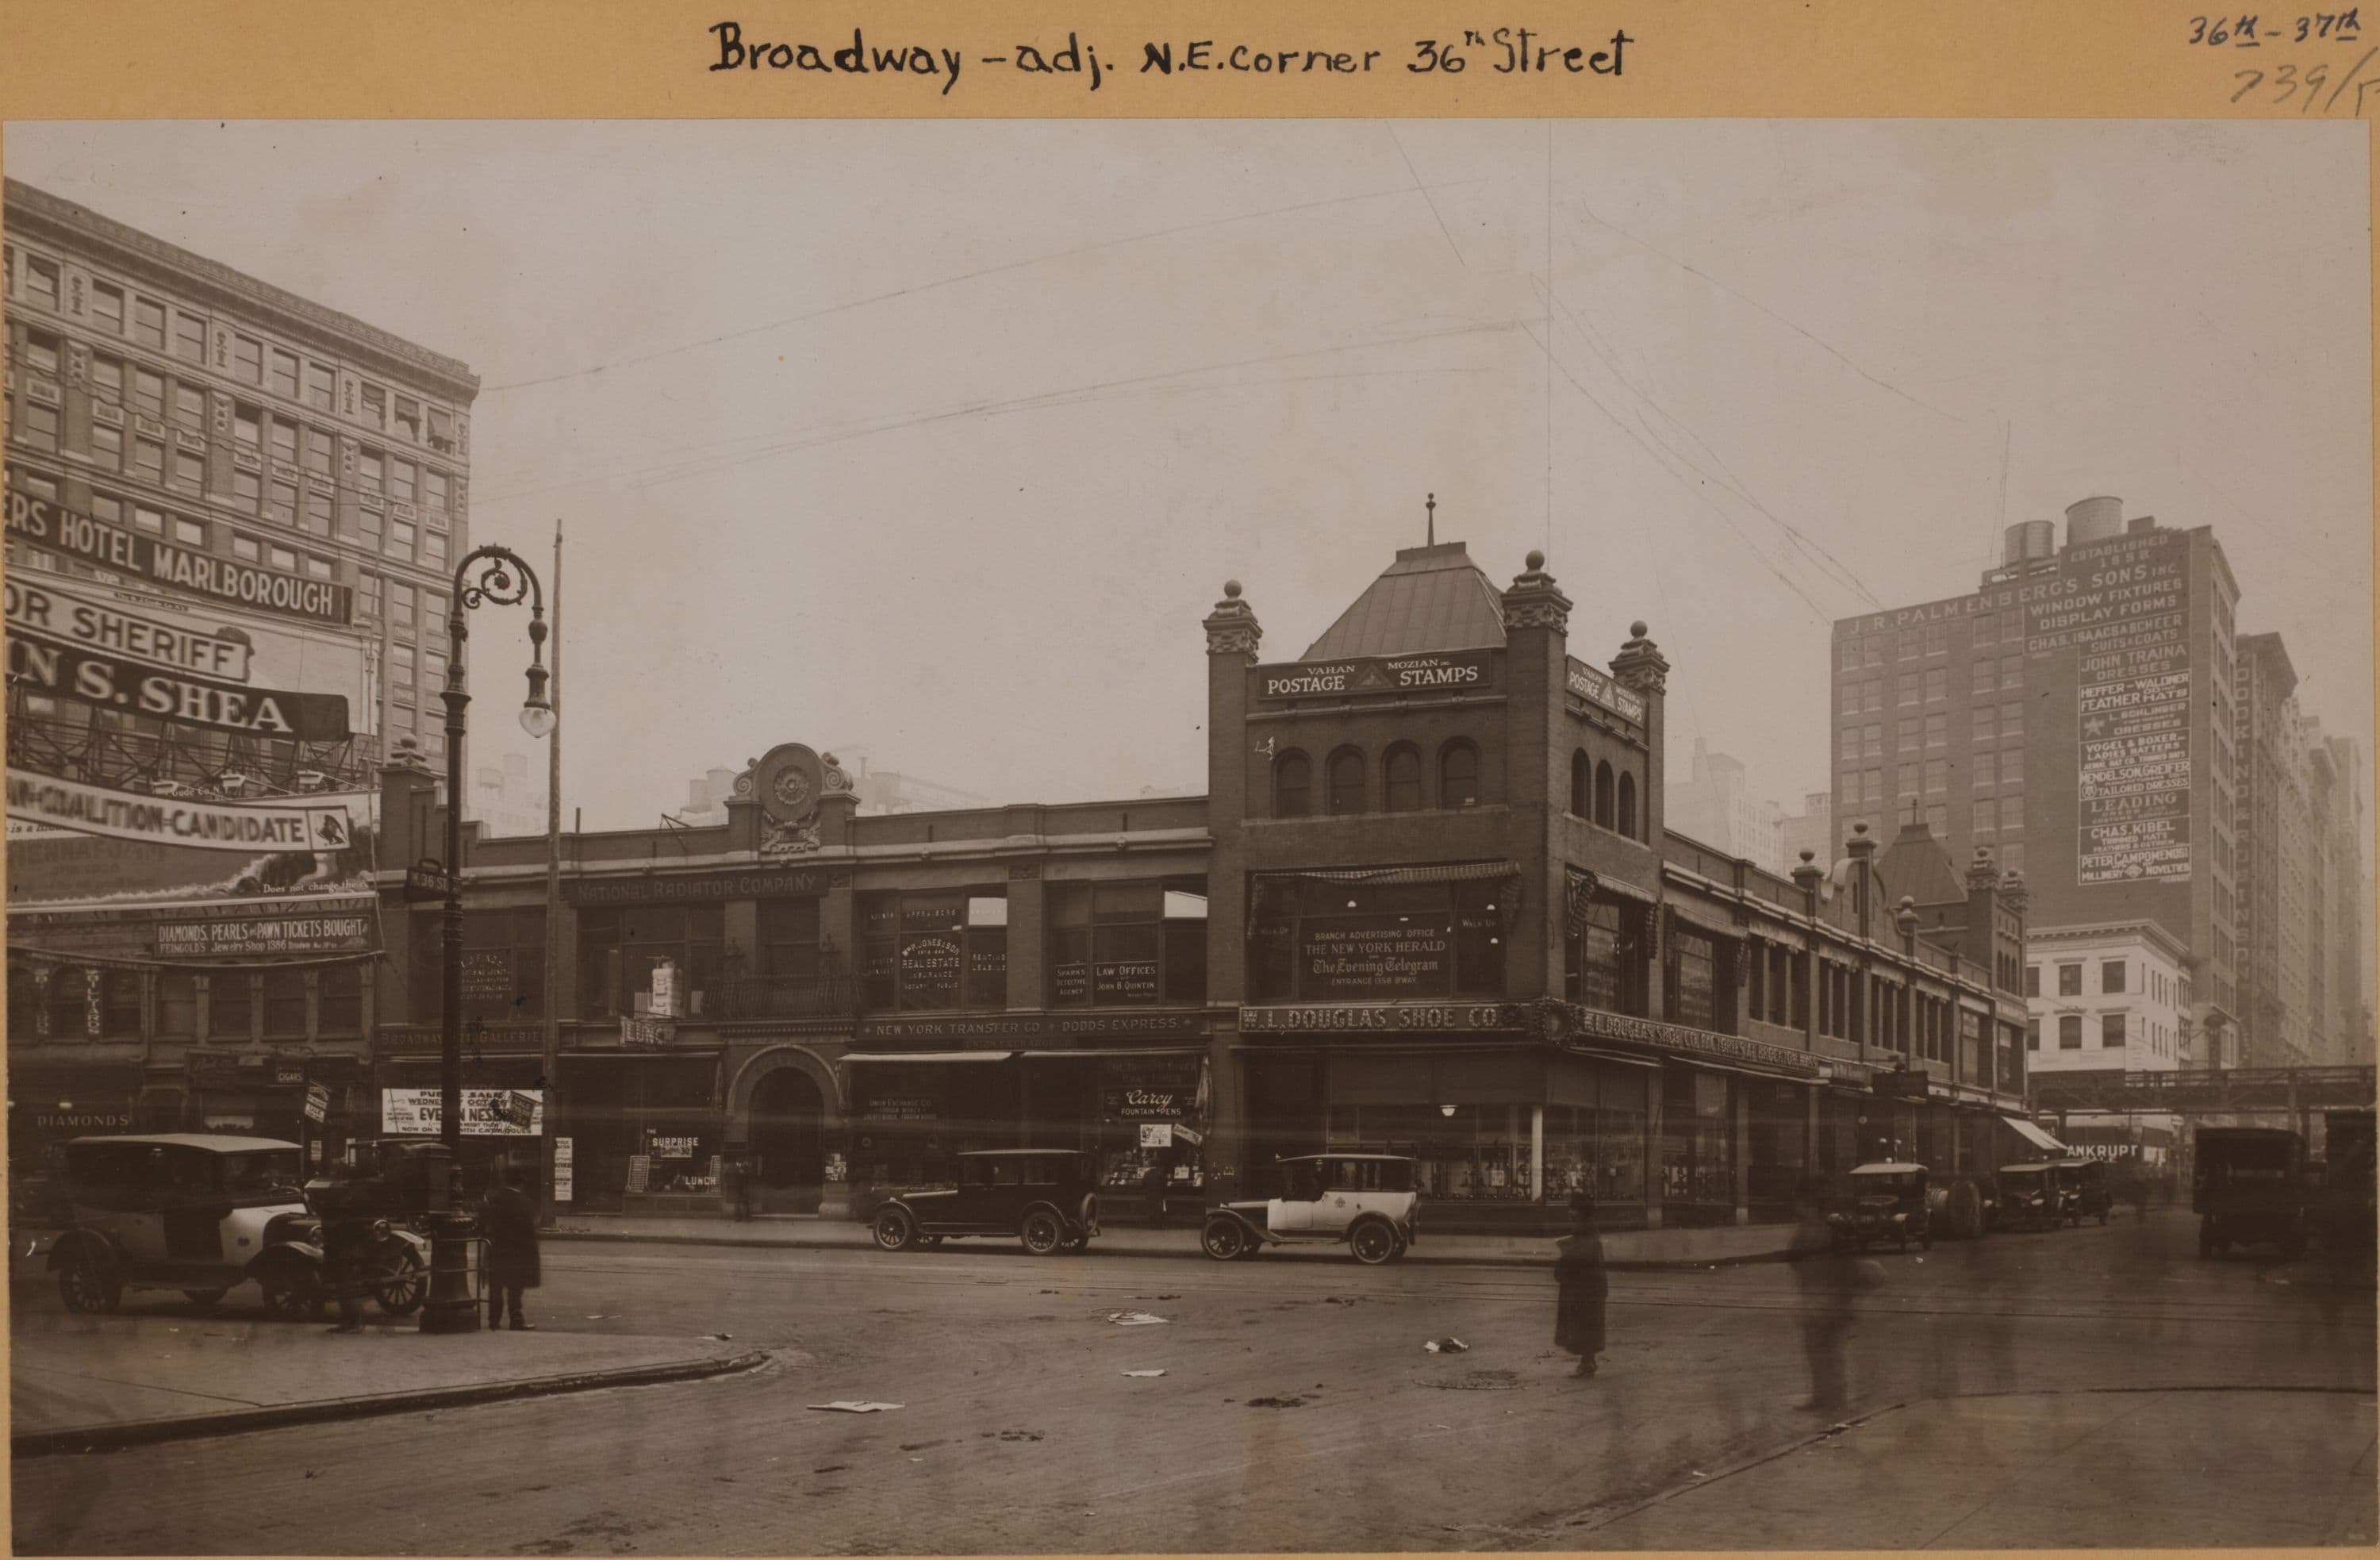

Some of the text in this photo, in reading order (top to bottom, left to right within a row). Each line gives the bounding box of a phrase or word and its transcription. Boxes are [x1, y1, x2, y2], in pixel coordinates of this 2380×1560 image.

[708, 24, 962, 93] Broadway
[1406, 29, 1484, 76] 36th
[1491, 28, 1635, 76] Street
[2071, 533, 2169, 563] ESTABLISHED
[60, 509, 333, 617] HOTEL MARLBOROUGH
[2091, 564, 2148, 589] SONS
[2029, 577, 2182, 617] WINDOW FIXTURES
[2040, 594, 2178, 631] DISPLAY FORMS
[71, 605, 234, 672] SHERIFF
[2134, 628, 2178, 646] COATS
[1306, 659, 1438, 676] VAHAN MOZIAN
[2080, 643, 2187, 673] JOHN TRAINA
[2096, 659, 2171, 682] DRESSES
[1267, 666, 1480, 696] POSTAGE STAMPS
[1569, 669, 1600, 700] POSTAGE
[138, 675, 294, 734] SHEA
[2081, 687, 2188, 713] FEATHER HATS
[2085, 740, 2126, 754] VOGEL
[2098, 782, 2144, 797] TAILORED
[2145, 777, 2189, 790] DRESSES
[2090, 792, 2178, 813] LEADING
[2132, 820, 2177, 834] KIBEL
[2081, 855, 2114, 869] PETER
[263, 882, 286, 894] Does
[290, 882, 305, 892] not
[308, 880, 340, 893] change
[421, 873, 435, 888] 36
[579, 872, 817, 903] NATIONAL RADIATOR COMPANY
[212, 923, 248, 940] PEARLS
[256, 921, 281, 939] PAWN
[282, 920, 322, 939] TICKETS
[323, 918, 363, 937] BOUGHT
[1315, 928, 1435, 941] BRANCH ADVERTISING OFFICE
[245, 941, 266, 951] Shop
[1306, 939, 1446, 955] THE NEW YORK HERALD
[927, 957, 961, 969] ESTATE
[1096, 964, 1156, 977] LAW OFFICES
[1313, 956, 1439, 977] The Evening Telegram
[877, 1025, 902, 1036] NEW
[908, 1024, 942, 1036] YORK
[949, 1021, 1019, 1035] TRANSFER
[1062, 1020, 1106, 1033] DODDS
[1288, 1009, 1388, 1029] DOUGLAS
[1398, 1008, 1457, 1029] SHOE
[1126, 1089, 1174, 1112] Carey
[37, 1114, 129, 1127] DIAMONDS
[1121, 1107, 1181, 1116] FOUNTAIN PENS
[653, 1136, 700, 1147] SURPRISE
[2067, 1143, 2139, 1158] ANKRUPT
[685, 1176, 717, 1186] LUNCH
